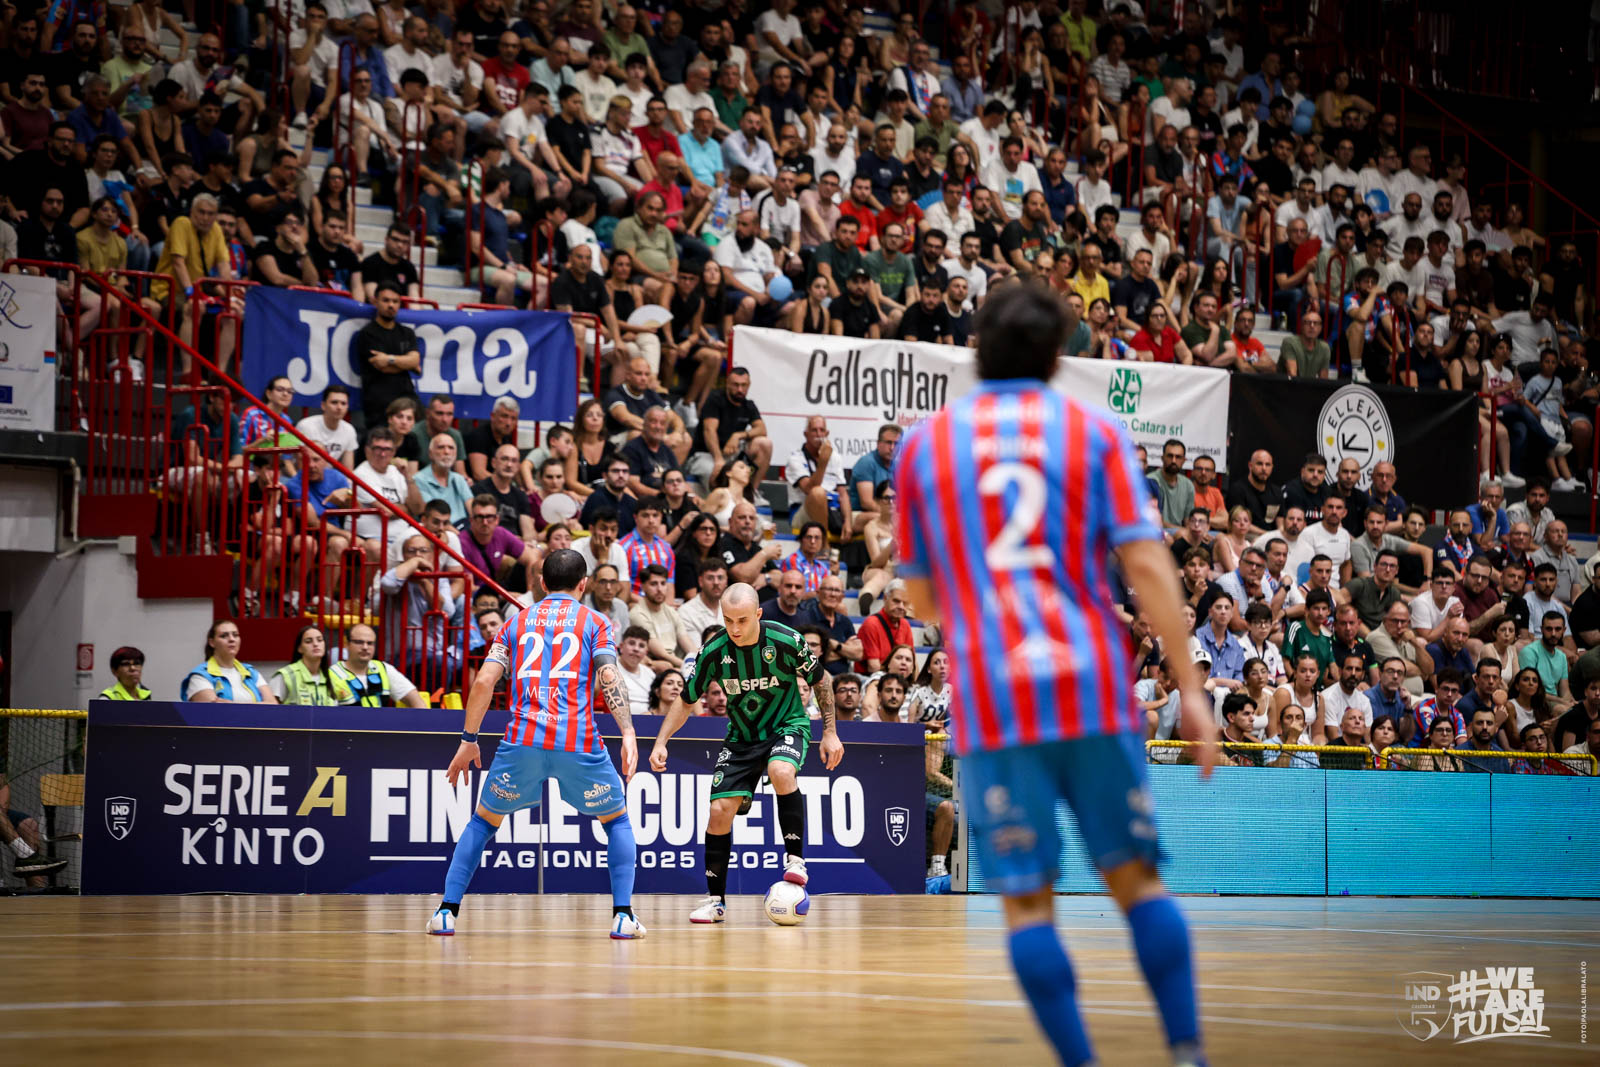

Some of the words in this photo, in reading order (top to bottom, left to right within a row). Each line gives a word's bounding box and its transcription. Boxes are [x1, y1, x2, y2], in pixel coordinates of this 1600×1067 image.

[1131, 418, 1166, 436] Catara
[1169, 424, 1184, 436] srl
[847, 438, 878, 455] ADAT
[978, 462, 1056, 572] 2
[525, 618, 577, 628] MUSUMECI
[517, 631, 580, 680] 22
[525, 685, 563, 700] META
[740, 676, 780, 692] SPEA
[784, 735, 795, 746] 9
[163, 763, 289, 816] SERIE
[296, 767, 347, 816] A
[111, 805, 130, 816] LND
[479, 851, 608, 868] TAGIONE
[634, 851, 695, 868] 025
